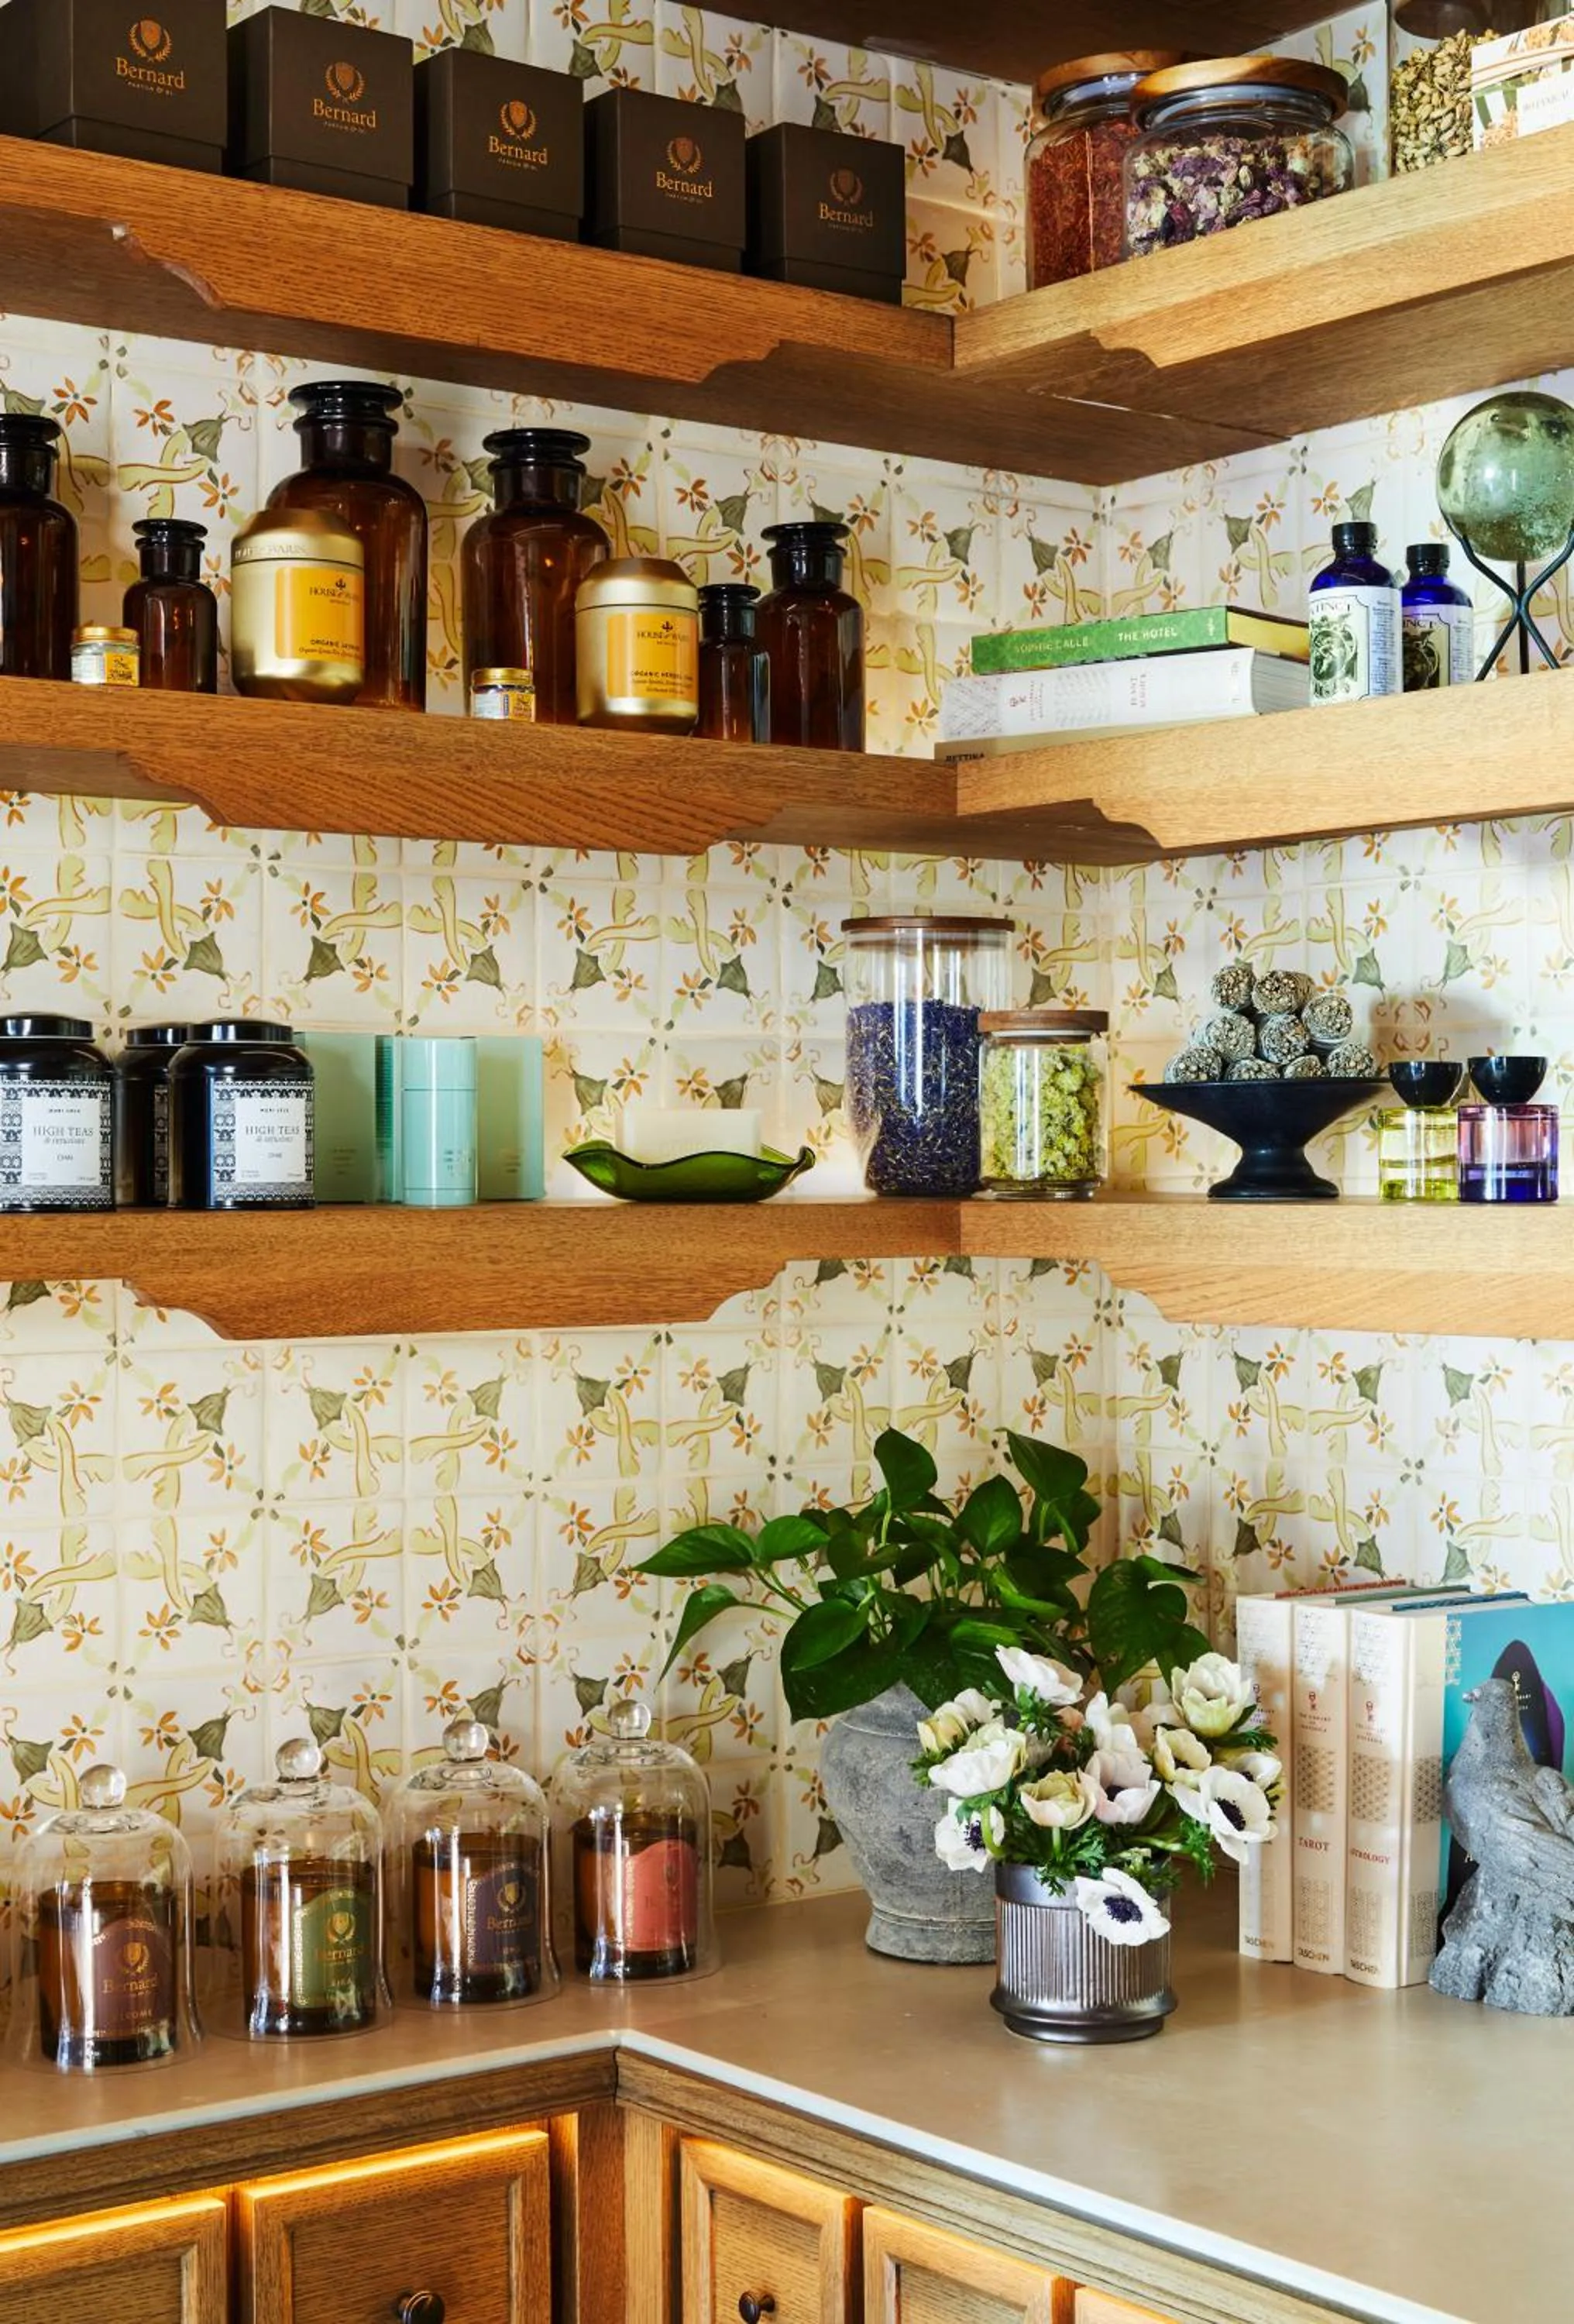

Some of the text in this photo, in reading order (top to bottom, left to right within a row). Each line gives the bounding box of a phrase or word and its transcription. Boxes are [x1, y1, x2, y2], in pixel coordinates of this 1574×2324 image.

[115, 57, 186, 89] Bernard
[313, 98, 376, 129] Bernard
[489, 136, 548, 165] Bernard
[656, 171, 713, 198] Bernard
[819, 201, 874, 227] Bernard
[1118, 626, 1178, 642] THE HOTEL
[33, 1126, 94, 1137] HIGH TEAS
[246, 1125, 301, 1136] HIGH TEAS
[1298, 1837, 1330, 1852] TAROT
